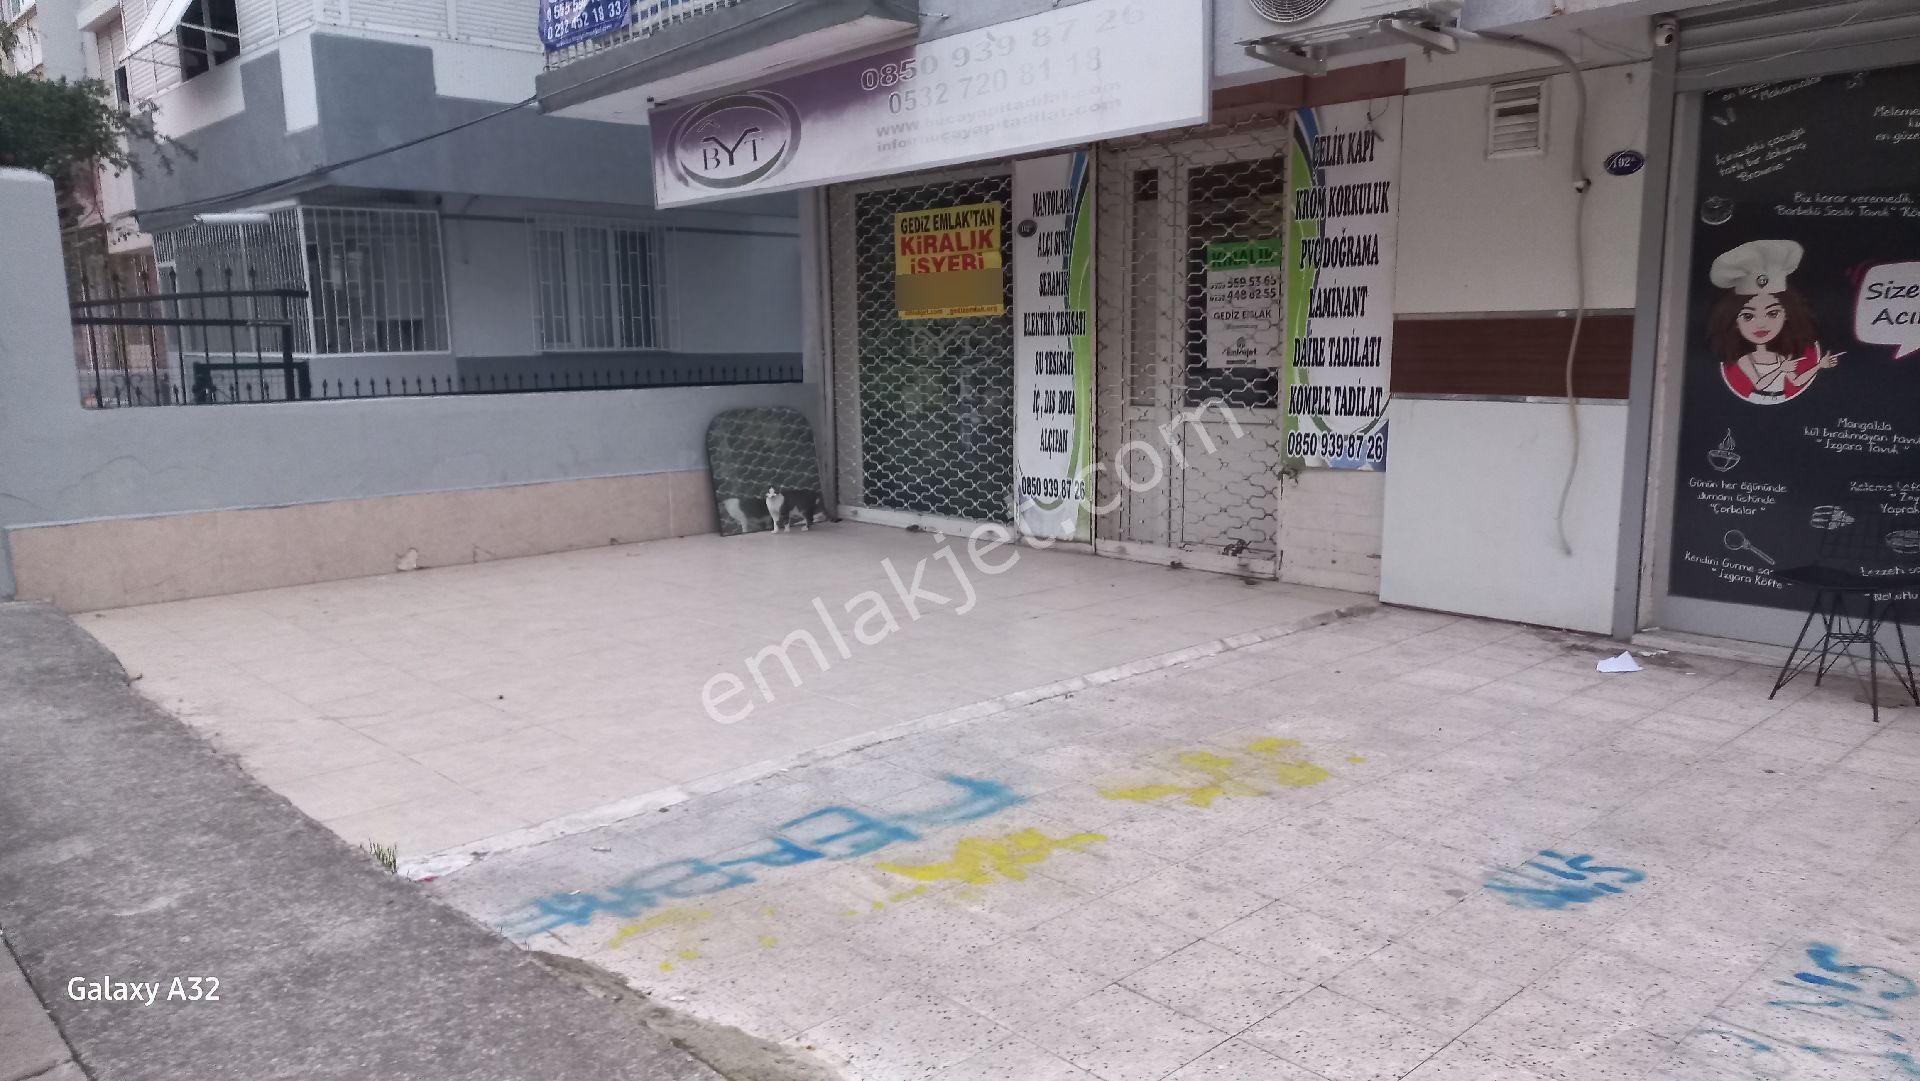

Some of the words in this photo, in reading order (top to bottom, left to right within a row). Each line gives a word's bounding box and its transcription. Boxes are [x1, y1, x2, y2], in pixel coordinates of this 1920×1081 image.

[592, 5, 604, 23] 18
[608, 1, 622, 18] 33
[861, 55, 938, 91] 0850
[952, 34, 1015, 68] 939
[1032, 19, 1080, 49] 87
[1097, 5, 1146, 34] 26
[889, 82, 949, 114] 0532
[959, 69, 1007, 100] 720
[702, 126, 765, 171] BYT
[1347, 130, 1375, 166] KAPI
[1295, 186, 1326, 220] KROM
[1328, 181, 1390, 218] KORKULUK
[933, 208, 995, 231] EMLAK'TAN
[900, 229, 994, 256] KİRALIK
[1299, 237, 1321, 270] PVC
[1322, 227, 1379, 268] DOĞRAMA
[1264, 288, 1276, 299] 55
[1865, 280, 1920, 300] Size
[1242, 309, 1271, 320] ELAK
[1293, 329, 1325, 367] DAİRE
[1328, 328, 1381, 367] TADİLATI
[1035, 351, 1043, 375] SU
[1058, 390, 1075, 415] BOYA
[1289, 385, 1330, 416] KOMPLE
[1334, 378, 1382, 417] TADİLAT
[1837, 417, 1891, 432] Mangalda
[1040, 428, 1068, 459] ALÇIPAN
[1287, 431, 1318, 456] 0850
[1321, 432, 1343, 458] 939
[1347, 434, 1364, 460] 87
[1366, 436, 1384, 461] 26
[1022, 476, 1041, 496] 0850
[1043, 478, 1059, 498] 939
[1061, 479, 1073, 499] 87
[1074, 480, 1085, 500] 26
[1689, 477, 1717, 489] Günün
[1721, 480, 1737, 490] her
[1685, 551, 1718, 566] Kendini
